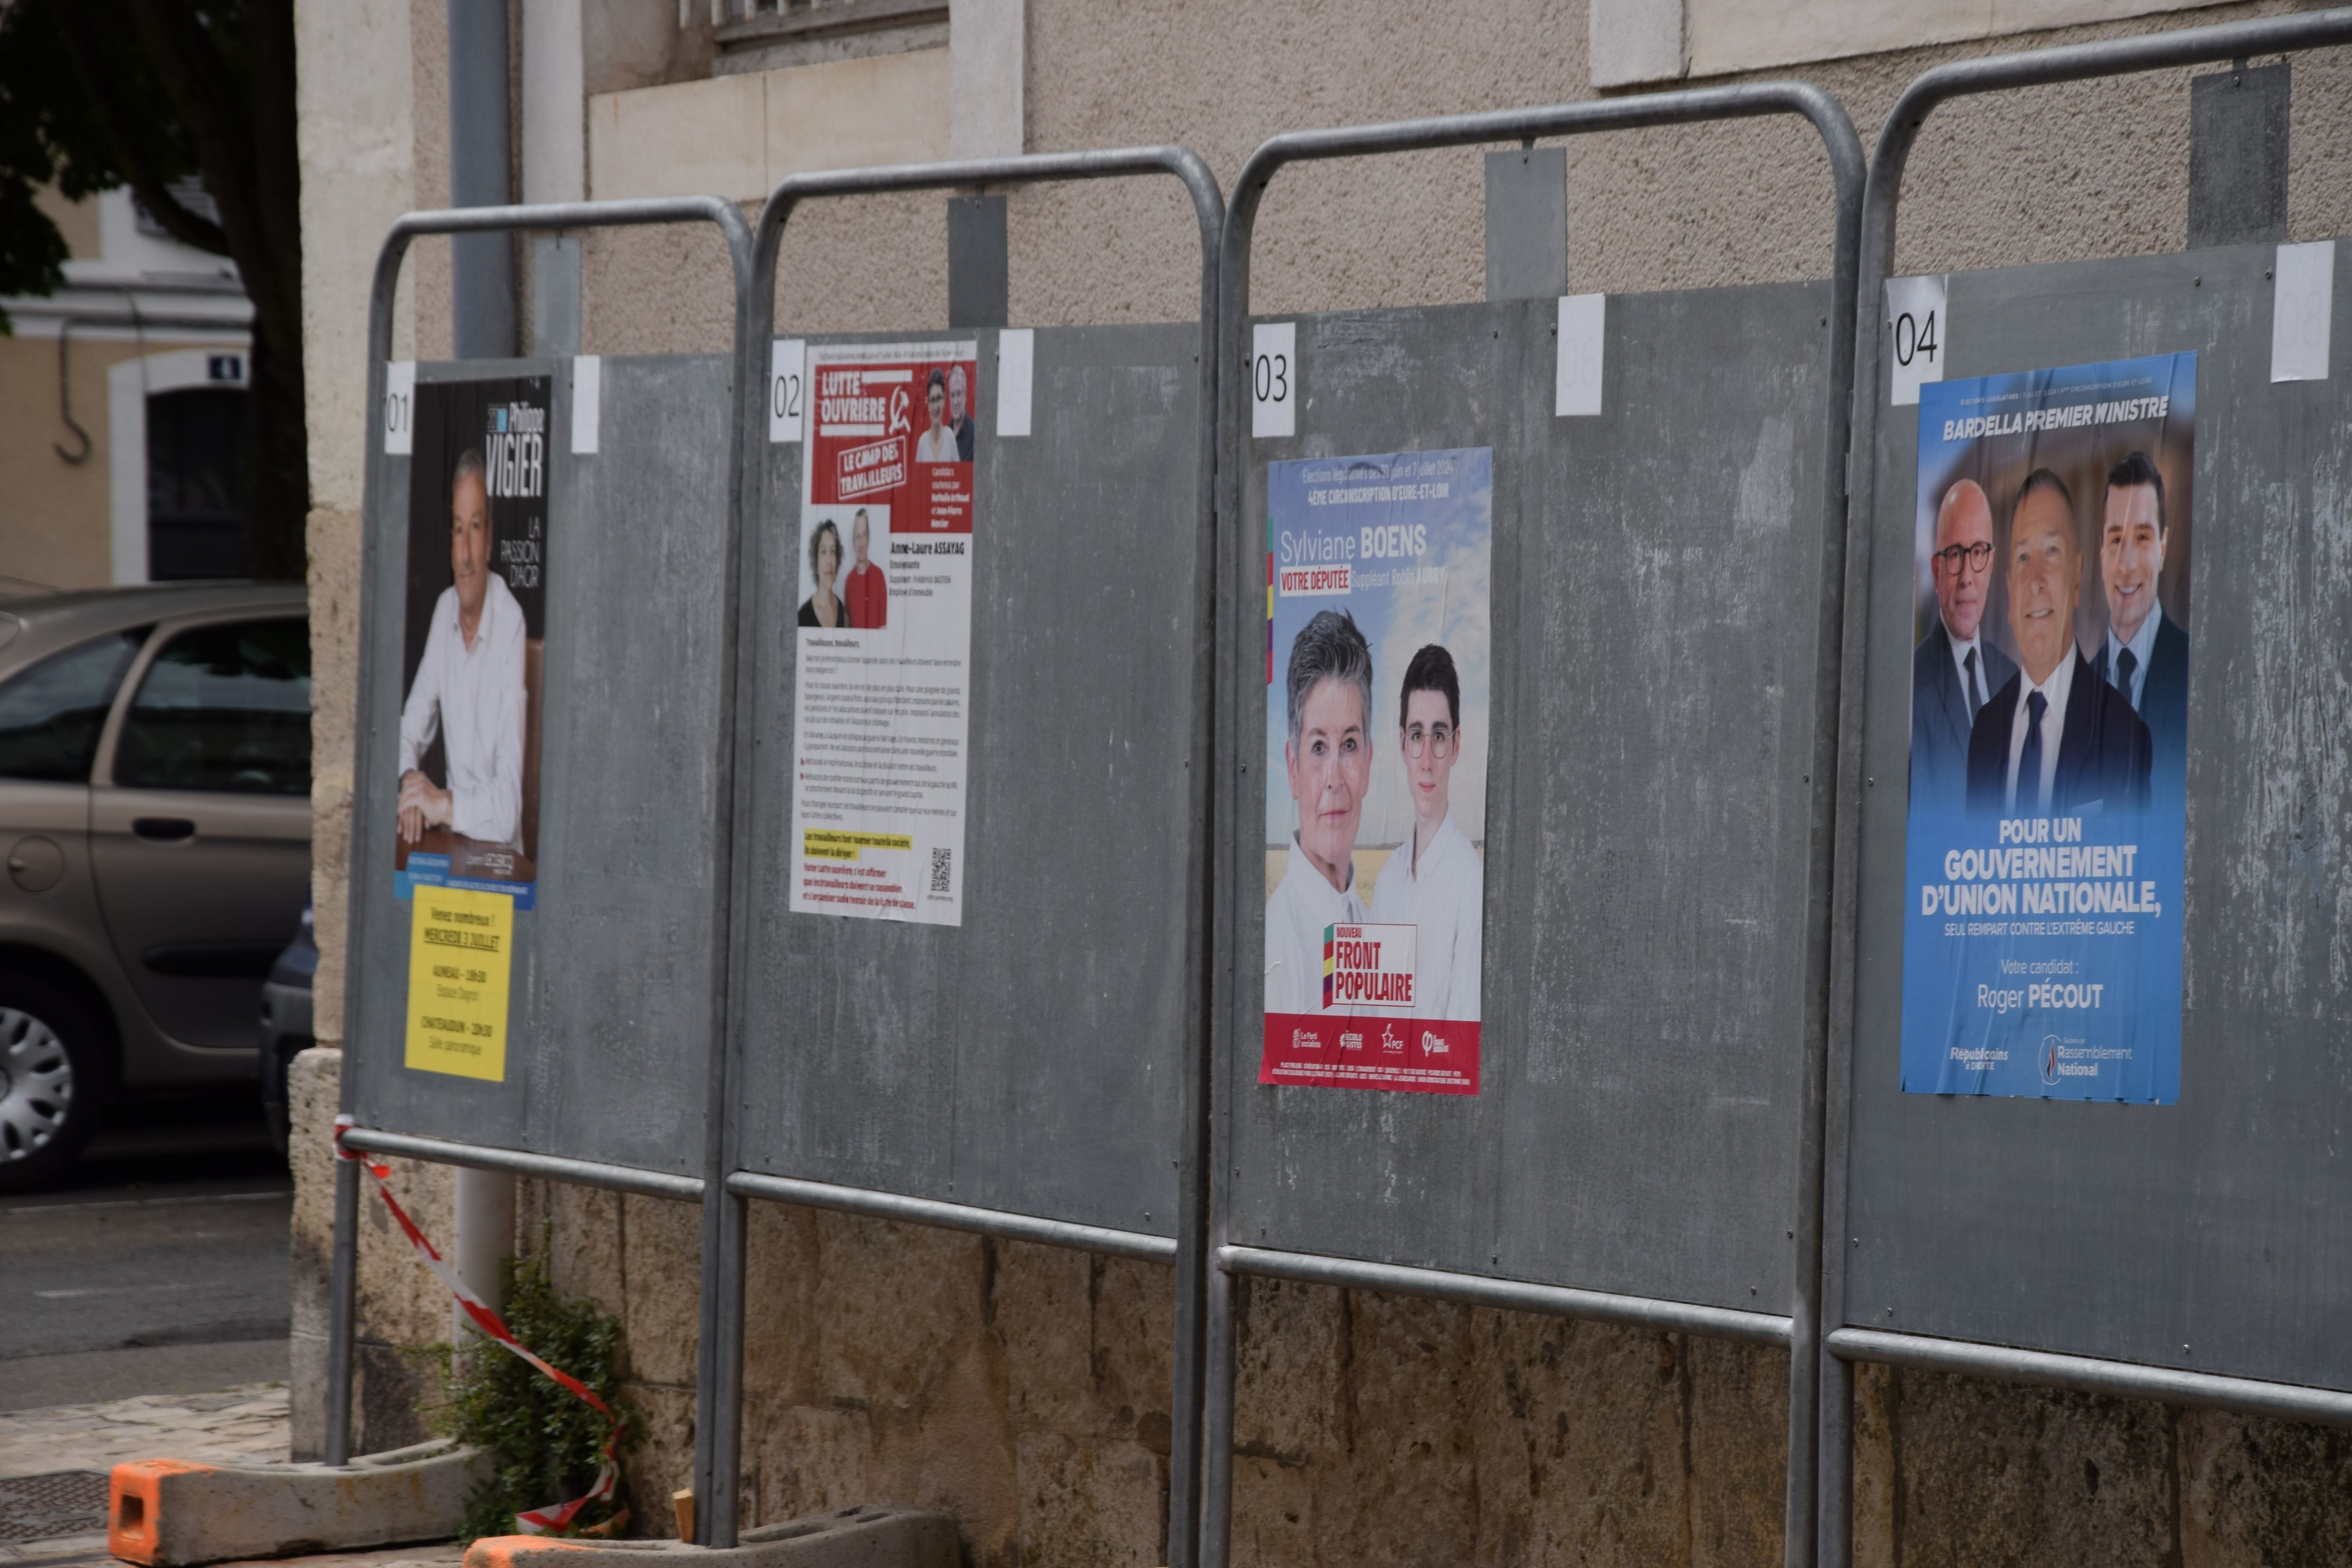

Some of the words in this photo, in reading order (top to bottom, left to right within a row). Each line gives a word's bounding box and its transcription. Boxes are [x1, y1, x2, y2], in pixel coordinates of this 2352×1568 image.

[1895, 310, 1937, 366] 04
[822, 371, 860, 396] LUTTE
[1255, 354, 1287, 402] 03
[774, 374, 799, 418] 02
[387, 393, 408, 433] 01
[509, 401, 544, 432] Philippe
[821, 397, 886, 423] OUVRIERE
[1943, 413, 2022, 441] BARDELLA
[2025, 404, 2093, 432] PREMIER
[2095, 395, 2169, 424] MINISTRE
[486, 433, 543, 498] VIGIER
[843, 454, 854, 471] LE
[855, 445, 881, 470] CAMP
[882, 442, 899, 463] DES
[841, 463, 903, 494] TRAVAILLEURS
[1390, 463, 1403, 481] juin
[1405, 464, 1411, 477] et
[1412, 462, 1416, 477] 7
[1417, 461, 1435, 480] juillet
[1437, 459, 1453, 475] 2024
[1308, 486, 1327, 505] 4ÈME
[1328, 486, 1391, 504] CIRCONSCRIPTION
[1392, 482, 1449, 501] D'EURE-ET-LOIR
[528, 516, 540, 539] LA
[501, 540, 540, 563] PASSION
[890, 541, 932, 555] Anne-Laure
[934, 541, 964, 555] ASSAYAG
[1281, 529, 1355, 566] Sylviane
[1360, 524, 1426, 558] BOENS
[1281, 572, 1308, 591] VOTRE
[1311, 565, 1349, 589] DÉPUTÉE
[1351, 570, 1389, 591] Suppléant
[1391, 567, 1414, 586] Robin
[1999, 818, 2049, 844] POUR
[2053, 817, 2081, 842] UN
[1945, 845, 2137, 880] GOUVERNEMENT
[1922, 884, 2016, 915] D'UNION
[2022, 881, 2161, 918] NATIONALE,
[1336, 926, 1362, 939] NOUVEAU
[1944, 923, 1965, 937] SEUL
[1968, 922, 2008, 936] REMPART
[2010, 922, 2045, 936] CONTRE
[2047, 918, 2094, 935] L'EXTRÊME
[2097, 921, 2134, 935] GAUCHE
[1336, 941, 1381, 970] FRONT
[2001, 959, 2026, 974] Votre
[2030, 959, 2073, 974] candidat
[1335, 971, 1413, 1002] POPULAIRE
[1978, 984, 2024, 1014] Roger
[2028, 978, 2103, 1009] PÉCOUT
[1391, 1041, 1403, 1050] PCF
[1950, 1047, 2008, 1063] Républicains
[2058, 1046, 2132, 1059] Rassemblement
[1965, 1062, 1970, 1070] à
[1971, 1061, 1994, 1070] DROITE
[2058, 1063, 2098, 1076] National
